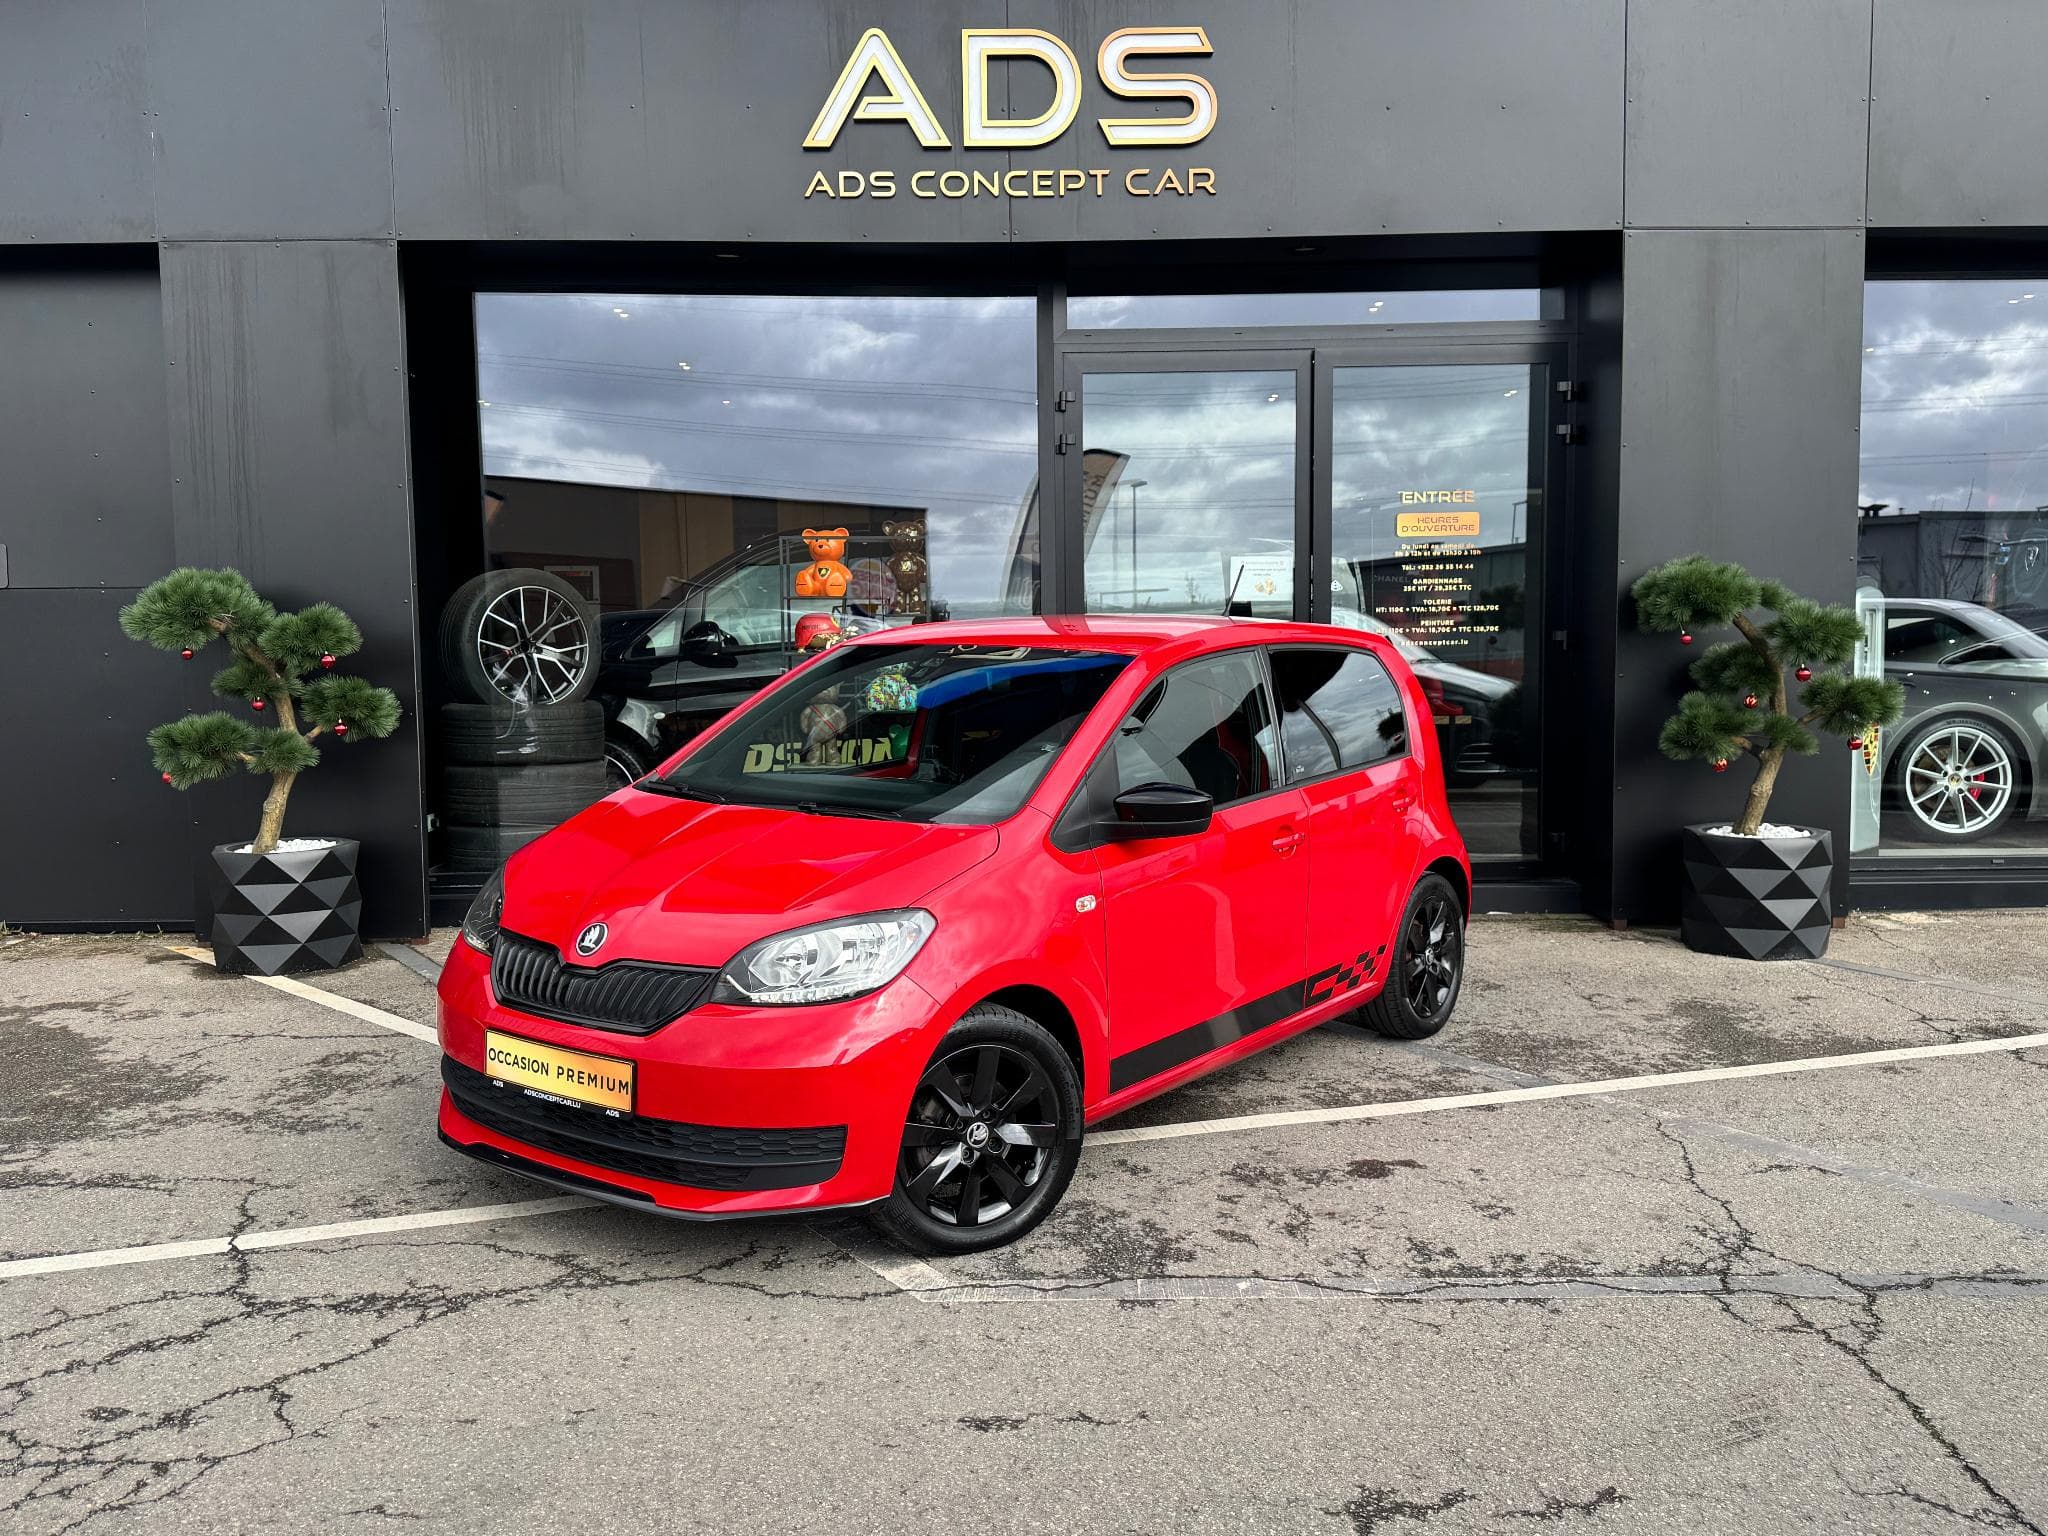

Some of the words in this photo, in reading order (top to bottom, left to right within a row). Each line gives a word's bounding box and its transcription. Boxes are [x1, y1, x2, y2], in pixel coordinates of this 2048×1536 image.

[802, 26, 1218, 148] ADS
[804, 169, 896, 198] ADS
[911, 169, 1110, 198] CONCEPT
[1124, 168, 1217, 196] CAR
[1401, 524, 1475, 533] D'OUVERTURE
[1417, 516, 1459, 524] HEURES
[1412, 543, 1429, 551] lundi
[1412, 577, 1463, 585] GARDIENNAGE
[488, 1047, 549, 1077] OCCASION
[556, 1065, 629, 1095] PREMIUM
[492, 1079, 504, 1088] ADS
[605, 1109, 620, 1118] ADS
